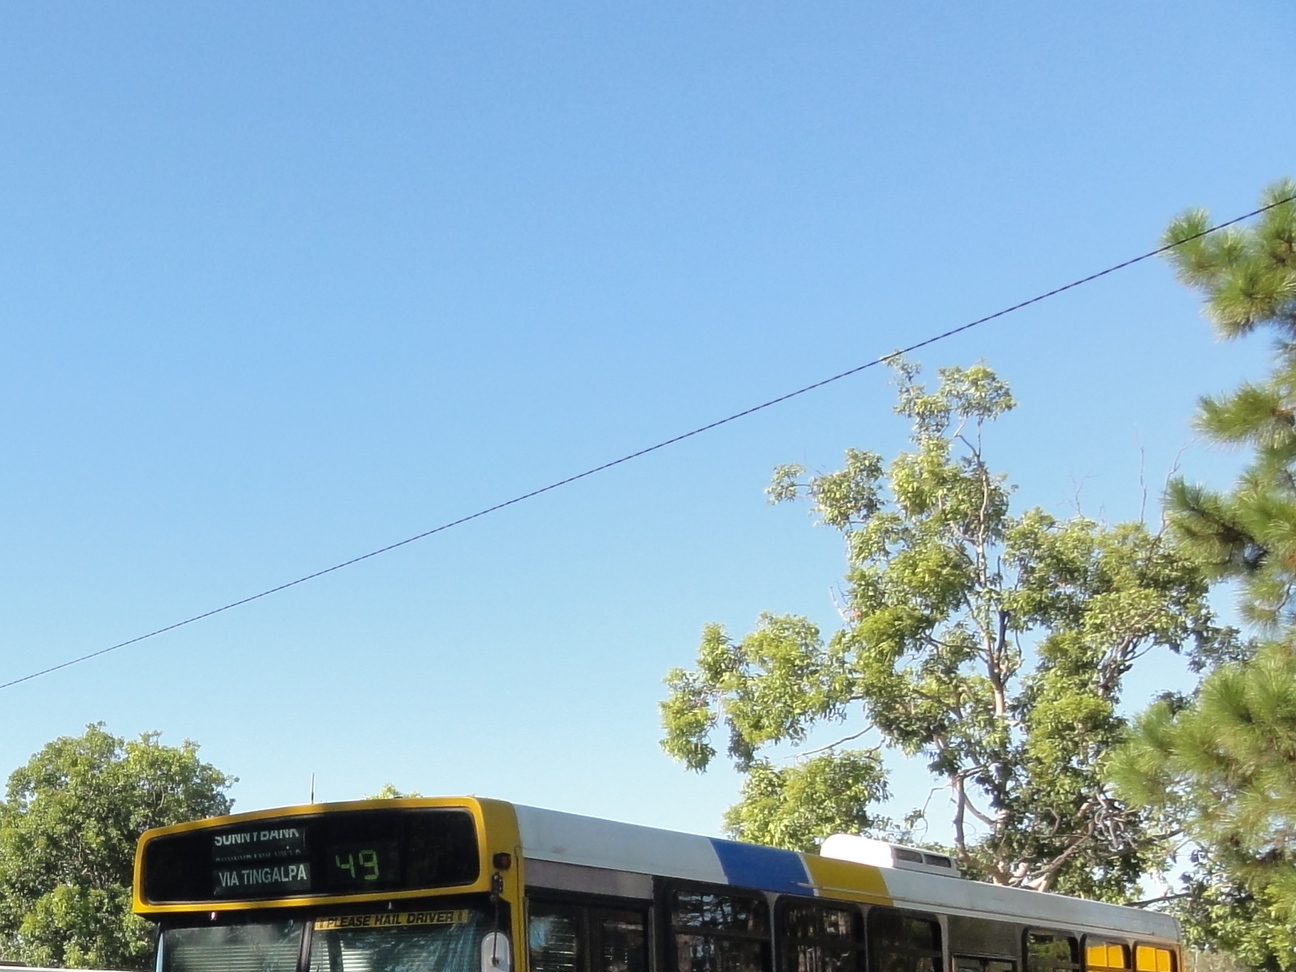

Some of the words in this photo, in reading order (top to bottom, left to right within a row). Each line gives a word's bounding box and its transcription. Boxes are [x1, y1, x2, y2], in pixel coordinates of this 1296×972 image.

[218, 869, 239, 887] VIA
[242, 864, 307, 885] TINGALPA
[335, 850, 379, 880] 49
[326, 914, 371, 928] PLEASE
[374, 913, 402, 926] HAIL
[406, 910, 454, 925] DRIVER
